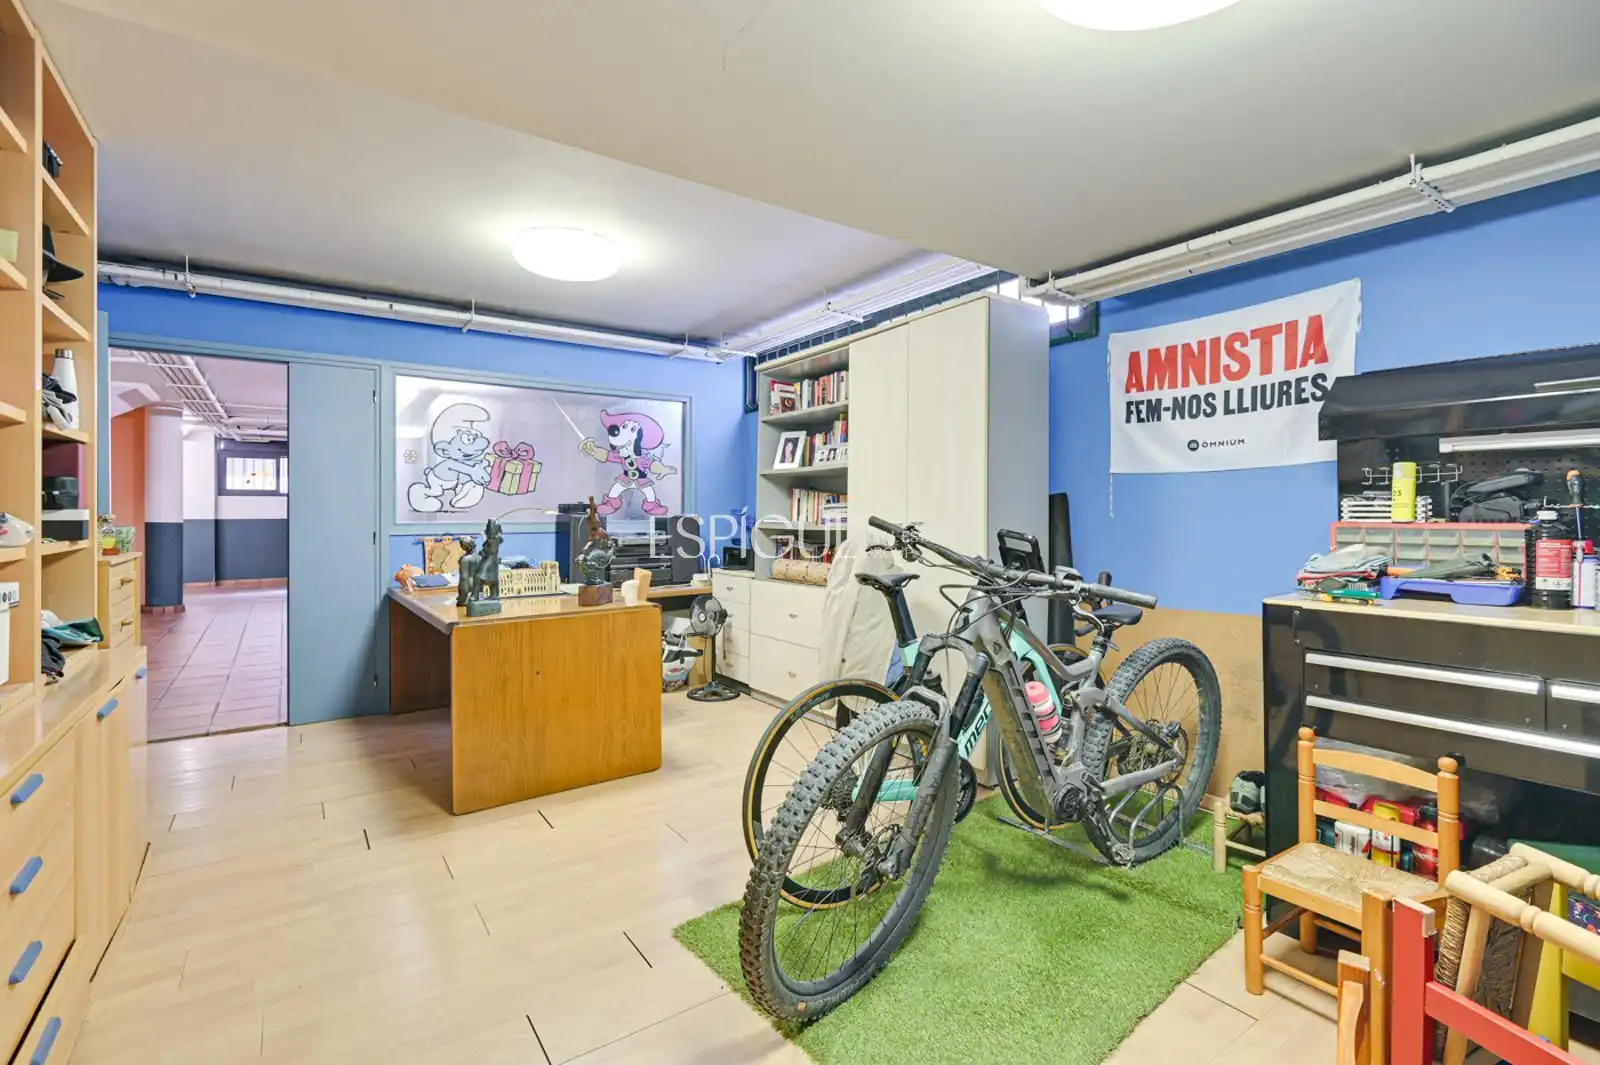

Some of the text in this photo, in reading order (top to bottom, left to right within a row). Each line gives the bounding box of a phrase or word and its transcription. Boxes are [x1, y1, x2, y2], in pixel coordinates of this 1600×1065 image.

[1124, 314, 1329, 394] AMNISTIA
[1125, 372, 1329, 424] FEM-NOS LLIURES
